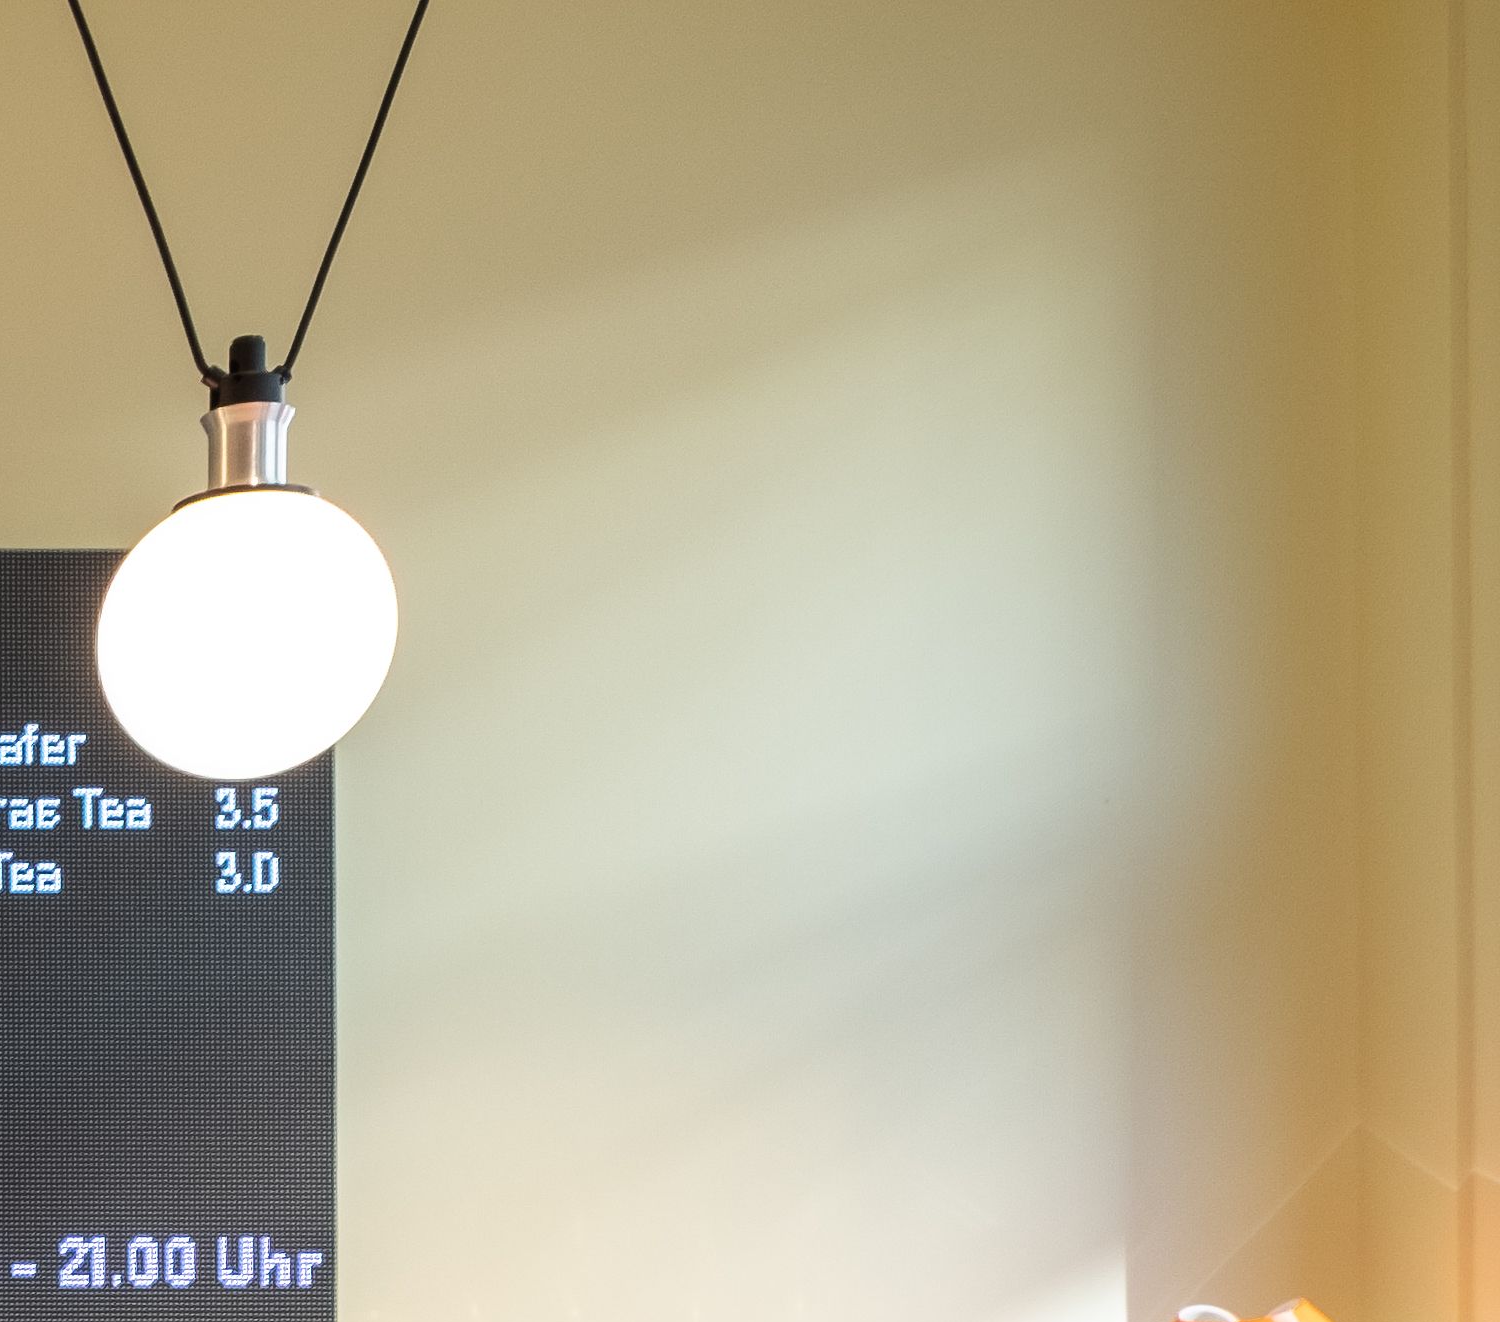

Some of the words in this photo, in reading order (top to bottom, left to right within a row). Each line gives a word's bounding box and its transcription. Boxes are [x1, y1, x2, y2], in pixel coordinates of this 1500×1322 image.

[72, 786, 152, 830] Tea
[214, 786, 279, 830] 3.5
[215, 850, 280, 894] 3.0
[58, 1234, 197, 1289] 21.00
[216, 1235, 323, 1289] Uhr
